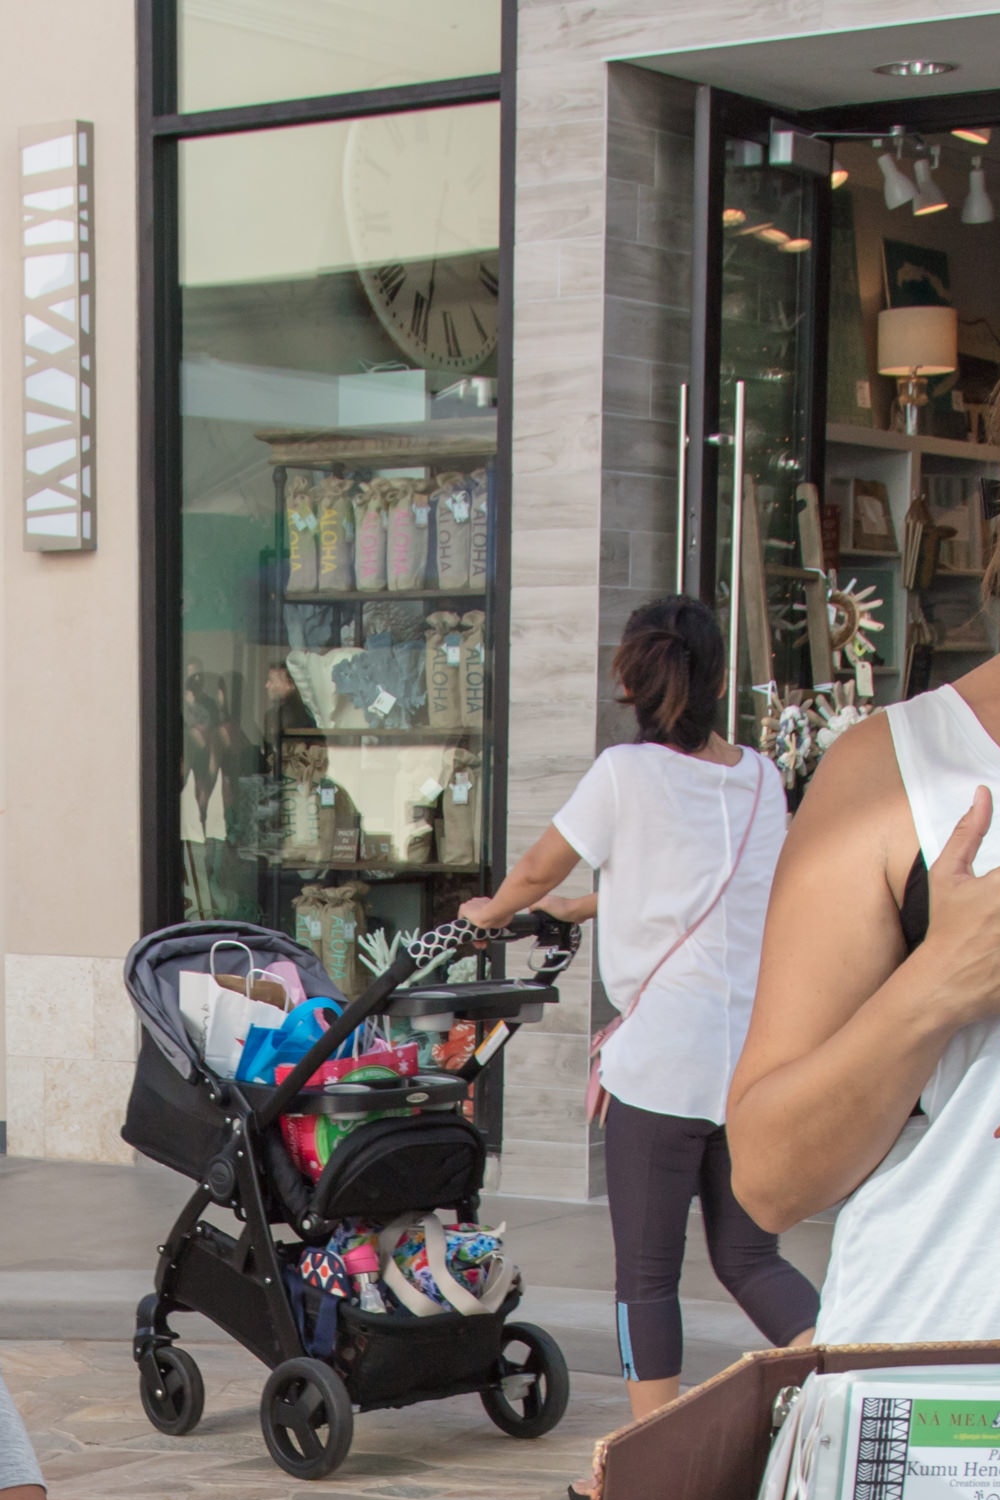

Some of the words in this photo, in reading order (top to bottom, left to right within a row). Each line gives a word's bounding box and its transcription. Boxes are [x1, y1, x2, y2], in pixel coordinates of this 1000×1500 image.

[320, 508, 338, 575] ALOHA
[361, 511, 379, 577] ALOHA
[393, 509, 411, 576] ALOHA
[439, 508, 453, 573] ALOHA
[472, 509, 487, 576] ALOHA
[431, 648, 449, 713] ALOHA
[466, 648, 484, 714] ALOHA
[281, 776, 297, 840] ALOHA
[330, 915, 348, 979] ALOHA
[950, 1413, 987, 1427] MEA
[907, 1461, 957, 1476] Kumu
[950, 1479, 990, 1487] Creations
